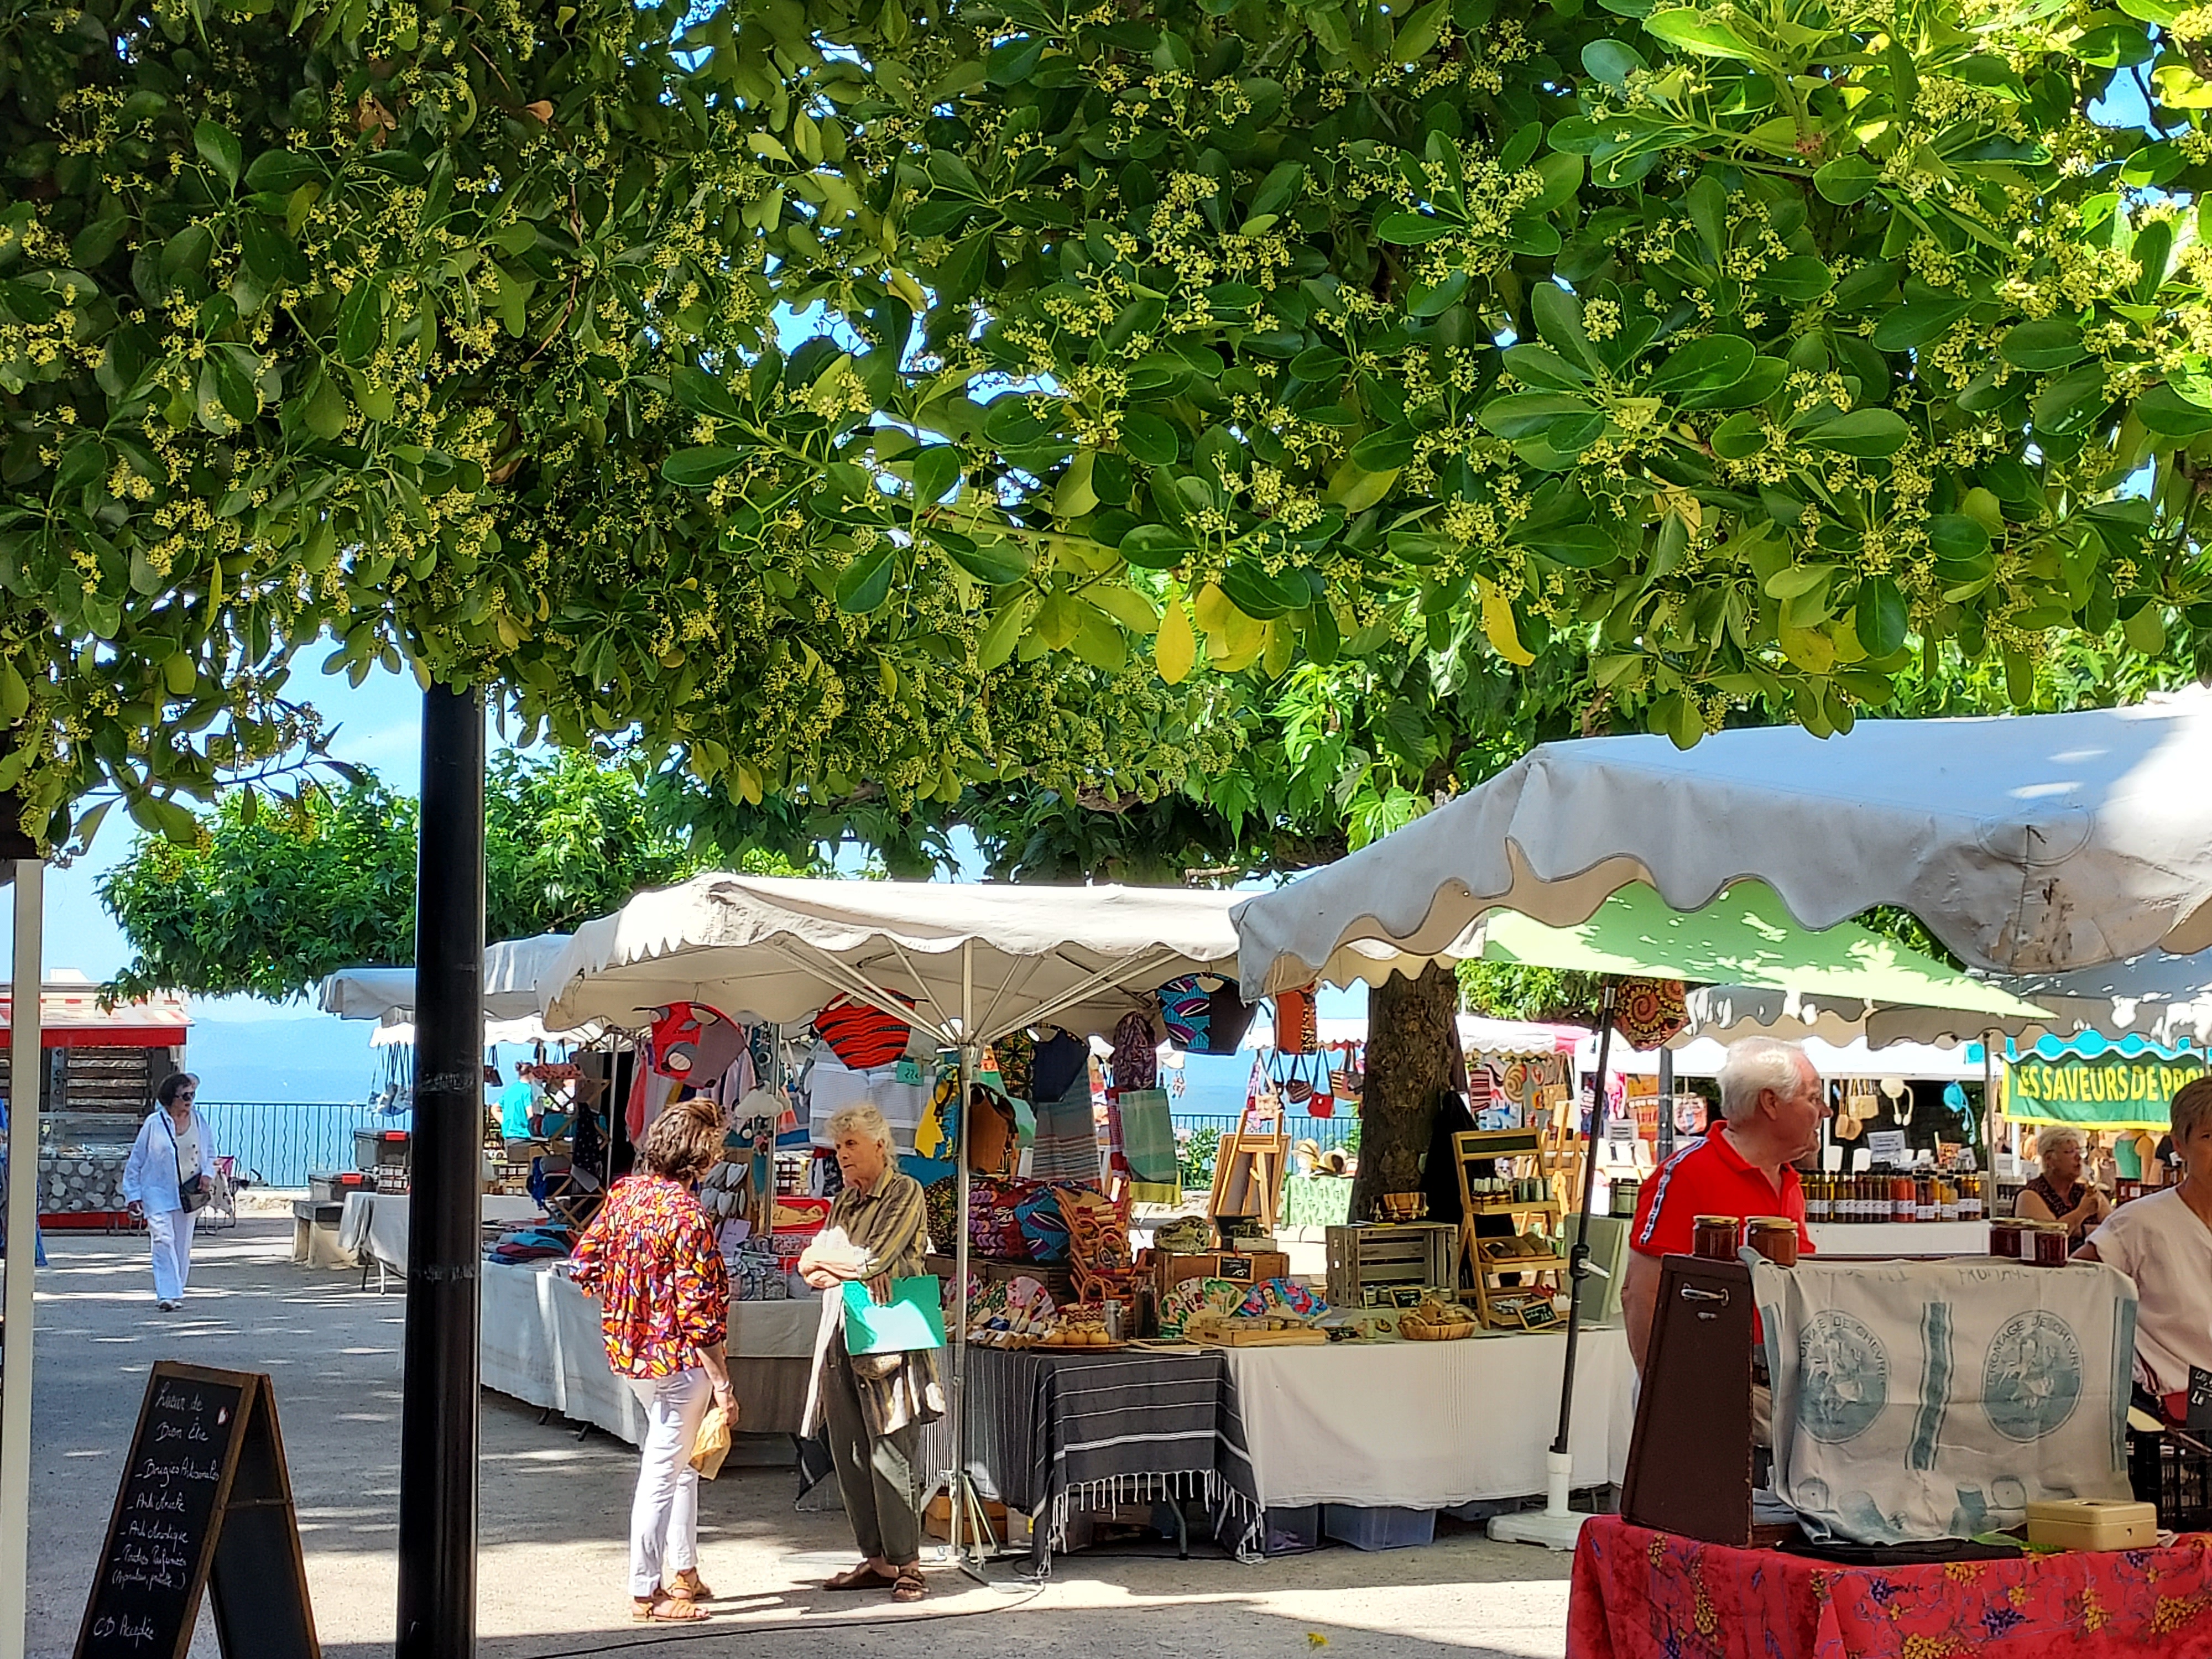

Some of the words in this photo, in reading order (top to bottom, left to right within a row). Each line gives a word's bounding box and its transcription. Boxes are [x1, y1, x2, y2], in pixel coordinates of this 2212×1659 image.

[2018, 1065, 2039, 1099] LES
[2042, 1066, 2129, 1101] SAVEURS
[2131, 1066, 2159, 1102] DE
[1833, 1316, 1850, 1330] DE
[1987, 1320, 2025, 1385] FROMAGE
